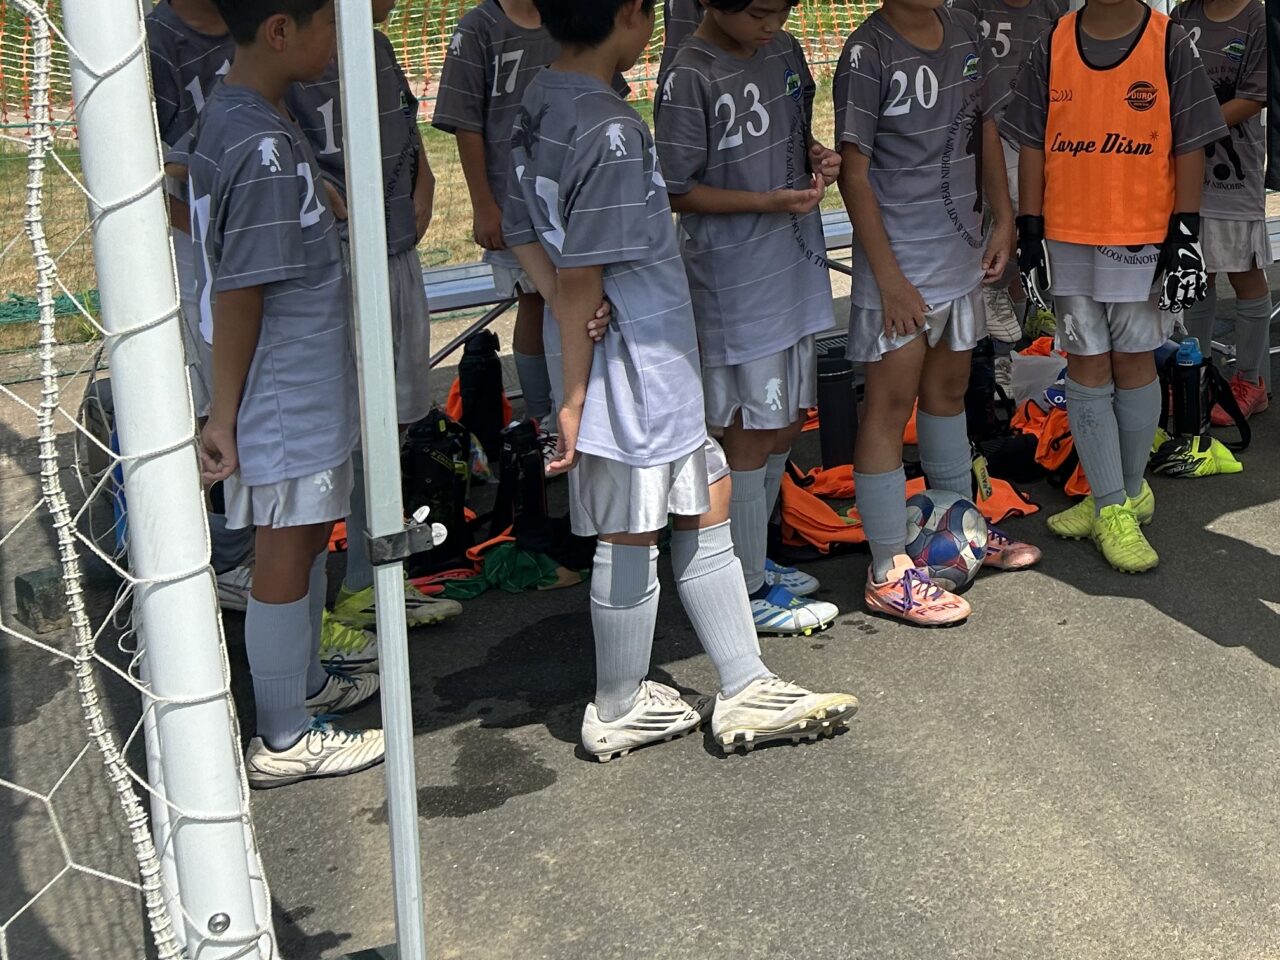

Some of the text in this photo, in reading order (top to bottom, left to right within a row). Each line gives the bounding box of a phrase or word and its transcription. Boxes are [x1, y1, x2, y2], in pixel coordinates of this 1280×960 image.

[492, 49, 524, 97] 17
[883, 64, 939, 117] 20
[714, 82, 771, 151] 23
[941, 136, 955, 178] NIHONJIN
[1050, 132, 1097, 157] Carpe
[941, 181, 953, 206] DEAD
[1123, 253, 1160, 265] IHONJIN
